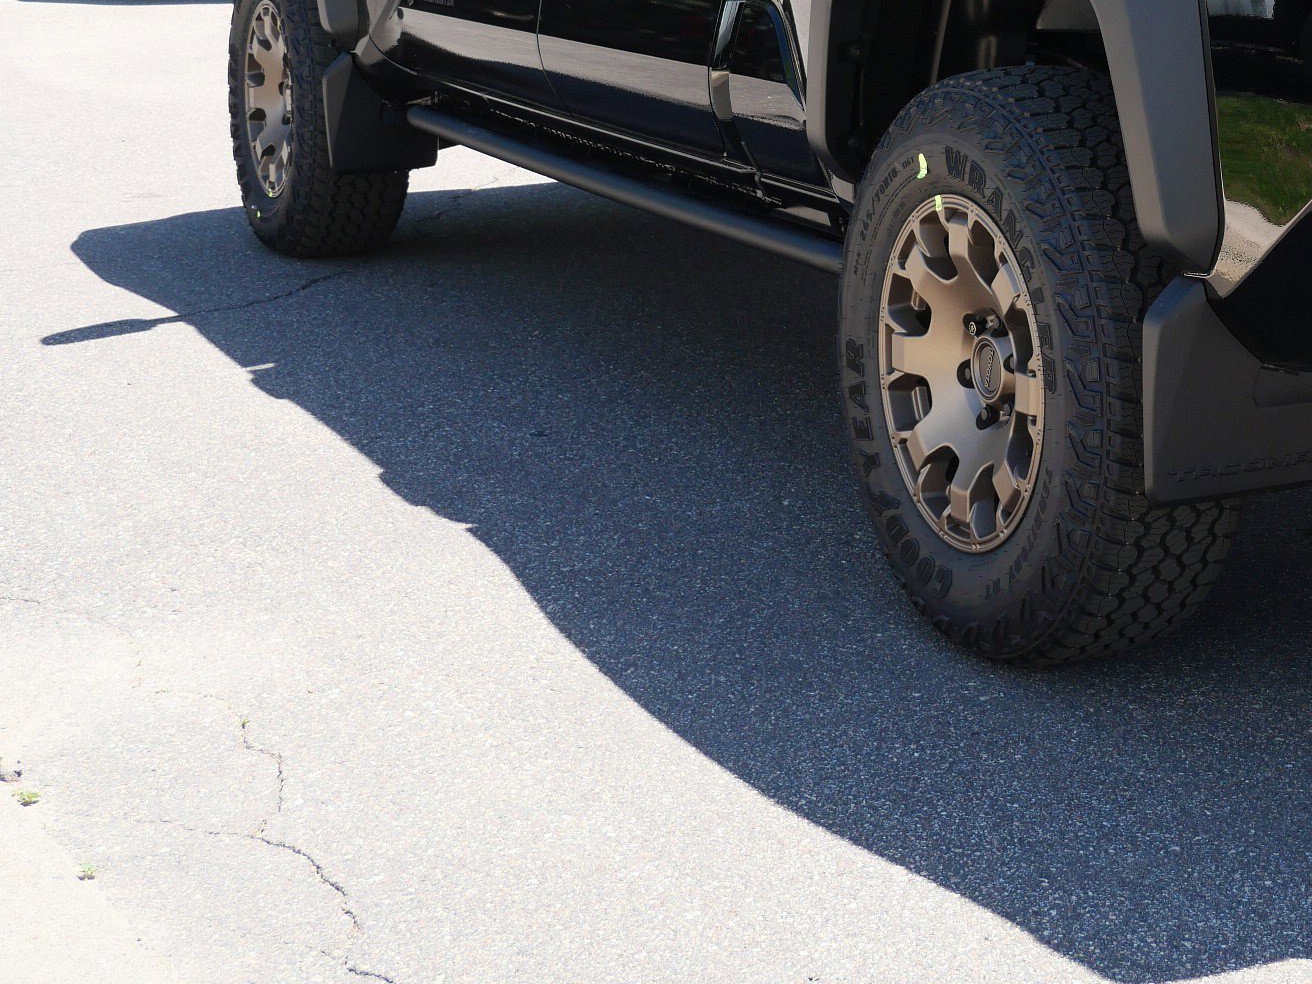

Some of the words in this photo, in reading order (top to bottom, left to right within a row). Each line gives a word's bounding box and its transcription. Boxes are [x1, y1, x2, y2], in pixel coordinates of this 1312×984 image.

[944, 145, 1056, 394] WRANGLER
[984, 349, 995, 388] TOYOTA
[844, 338, 953, 599] GOODYEAR
